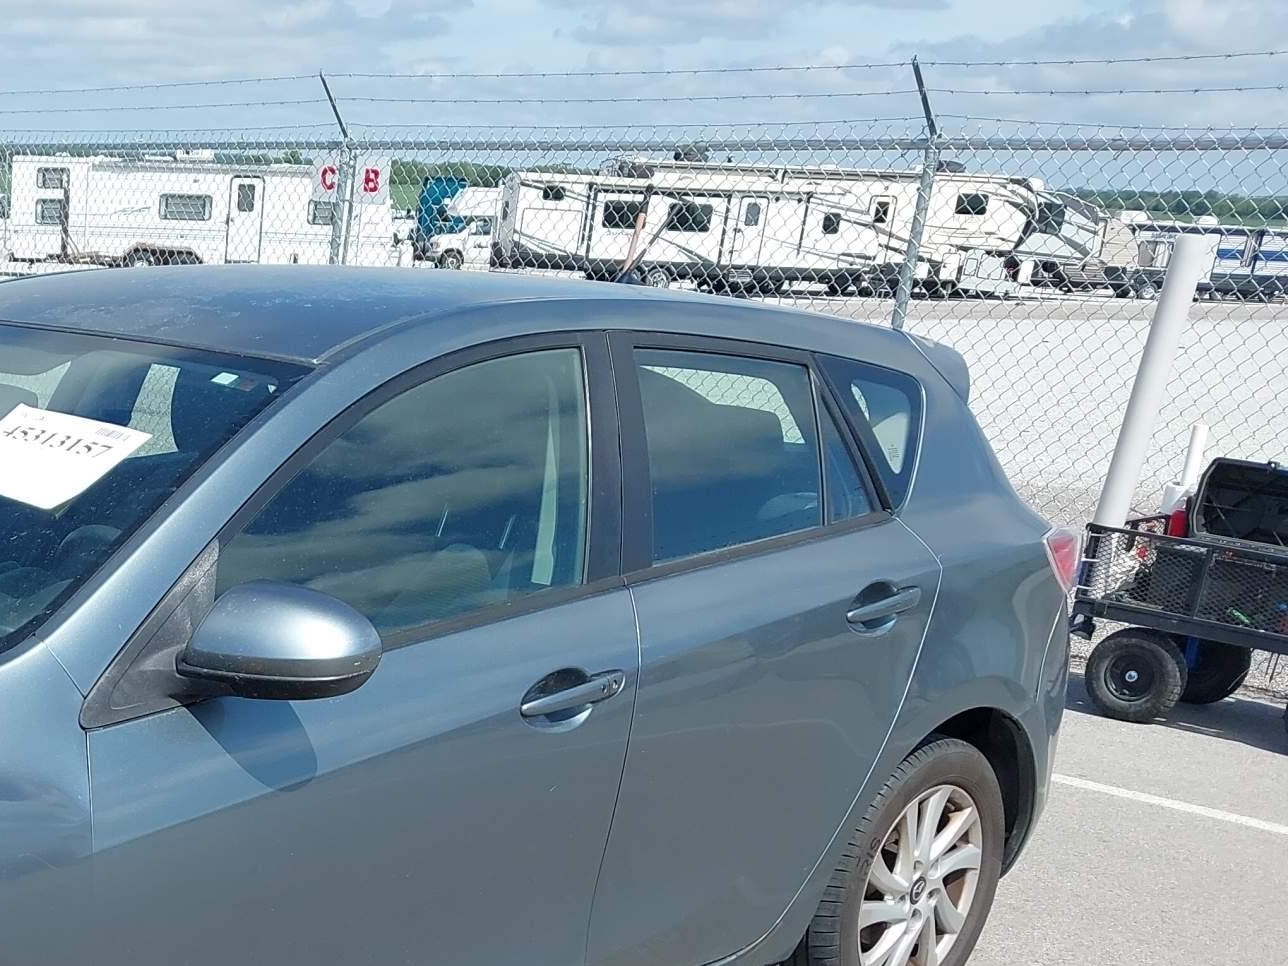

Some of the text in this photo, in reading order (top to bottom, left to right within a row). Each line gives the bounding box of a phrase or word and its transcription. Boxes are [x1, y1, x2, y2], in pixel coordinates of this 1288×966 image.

[321, 166, 337, 190] C
[364, 168, 380, 192] B
[3, 425, 114, 458] 45313157
